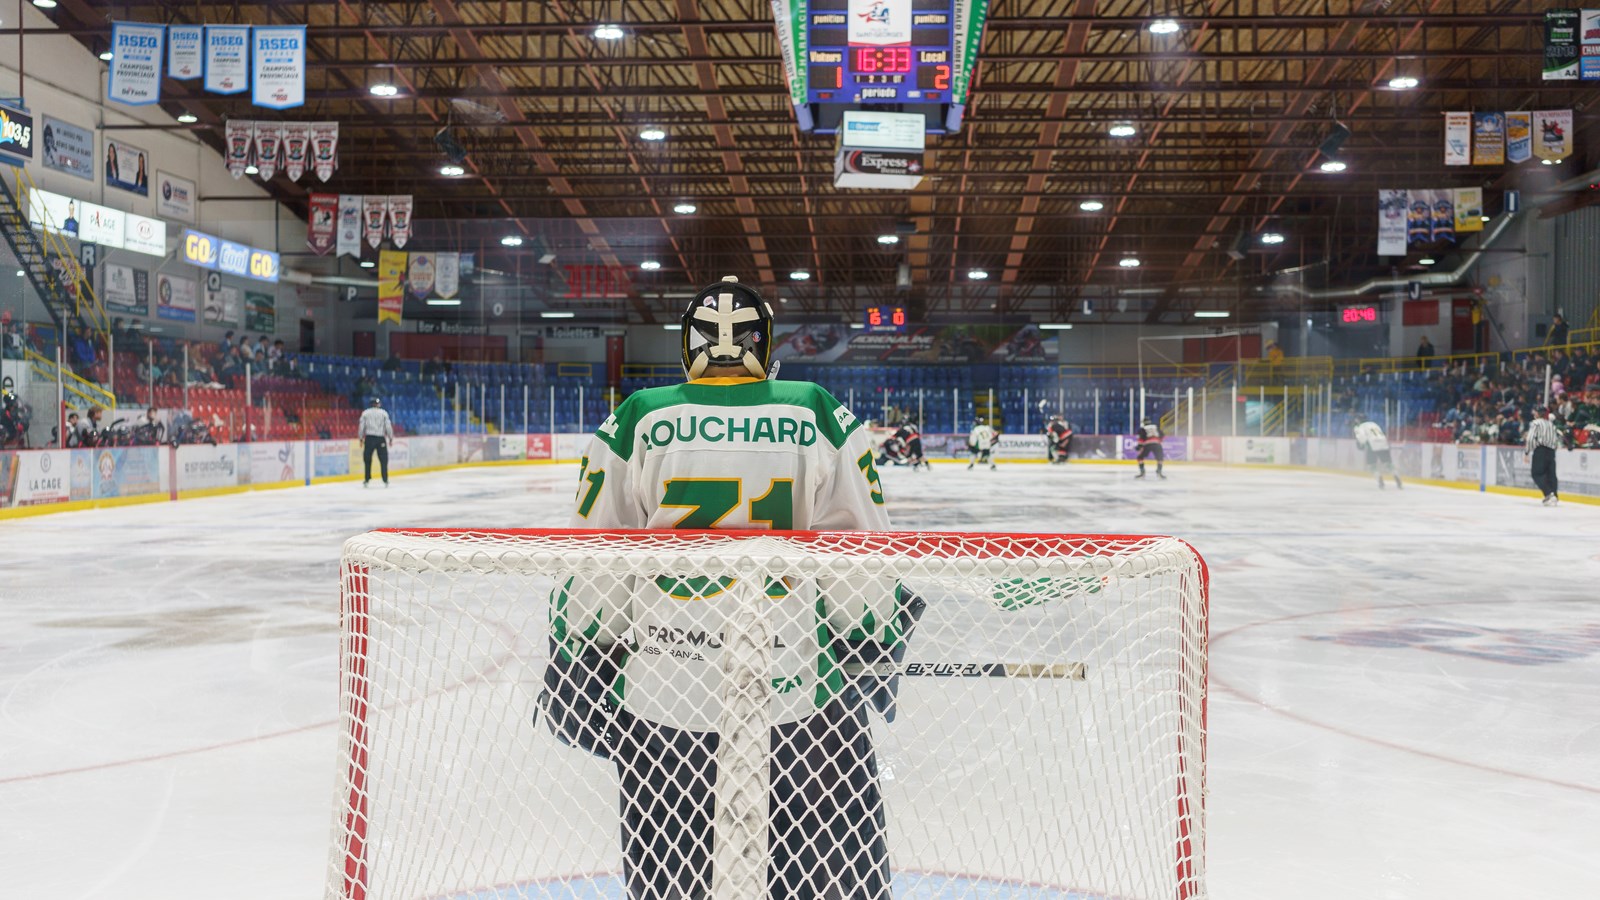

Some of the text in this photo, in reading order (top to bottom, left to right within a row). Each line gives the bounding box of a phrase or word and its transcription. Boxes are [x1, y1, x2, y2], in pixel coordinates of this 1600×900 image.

[118, 34, 158, 49] RSEQ
[173, 32, 199, 41] RSEQ
[211, 36, 244, 46] RSEQ
[259, 38, 299, 50] RSEQ
[857, 48, 911, 71] 16:33
[921, 51, 946, 62] Local
[836, 66, 842, 89] 1
[934, 65, 950, 90] 2
[1565, 69, 1578, 77] AA
[861, 157, 909, 169] Express
[82, 243, 95, 266] R
[185, 234, 211, 263] GO
[250, 252, 273, 278] GO
[1083, 300, 1092, 315] L
[29, 477, 62, 491] LA CAGE
